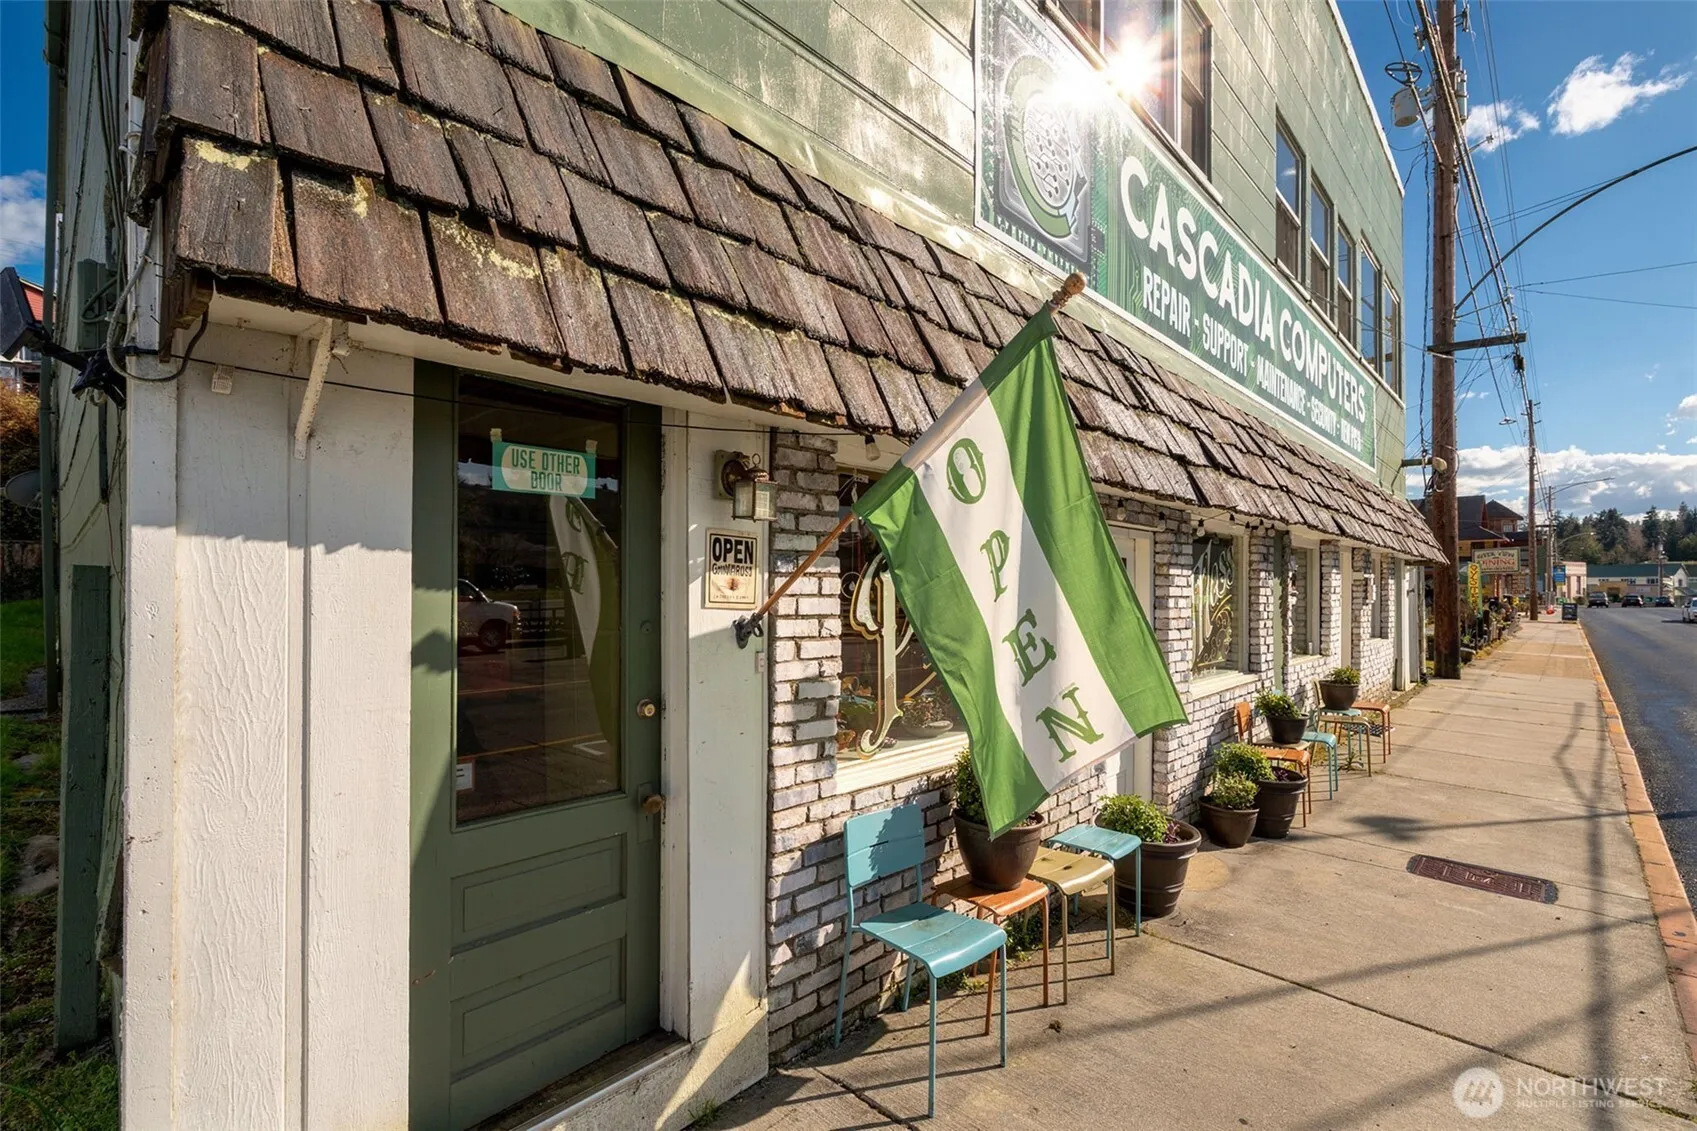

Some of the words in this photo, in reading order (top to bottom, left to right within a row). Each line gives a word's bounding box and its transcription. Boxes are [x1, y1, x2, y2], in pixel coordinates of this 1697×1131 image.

[1120, 156, 1276, 351] CASCADIA
[1279, 308, 1366, 423] COMPUTERS
[1143, 266, 1191, 337] REPAIR
[1202, 313, 1249, 377] SUPPORT
[511, 448, 536, 470] USE
[541, 452, 580, 475] OTHER
[530, 470, 563, 492] DOOR
[712, 537, 754, 565] OPEN
[946, 438, 1104, 763] OPEN
